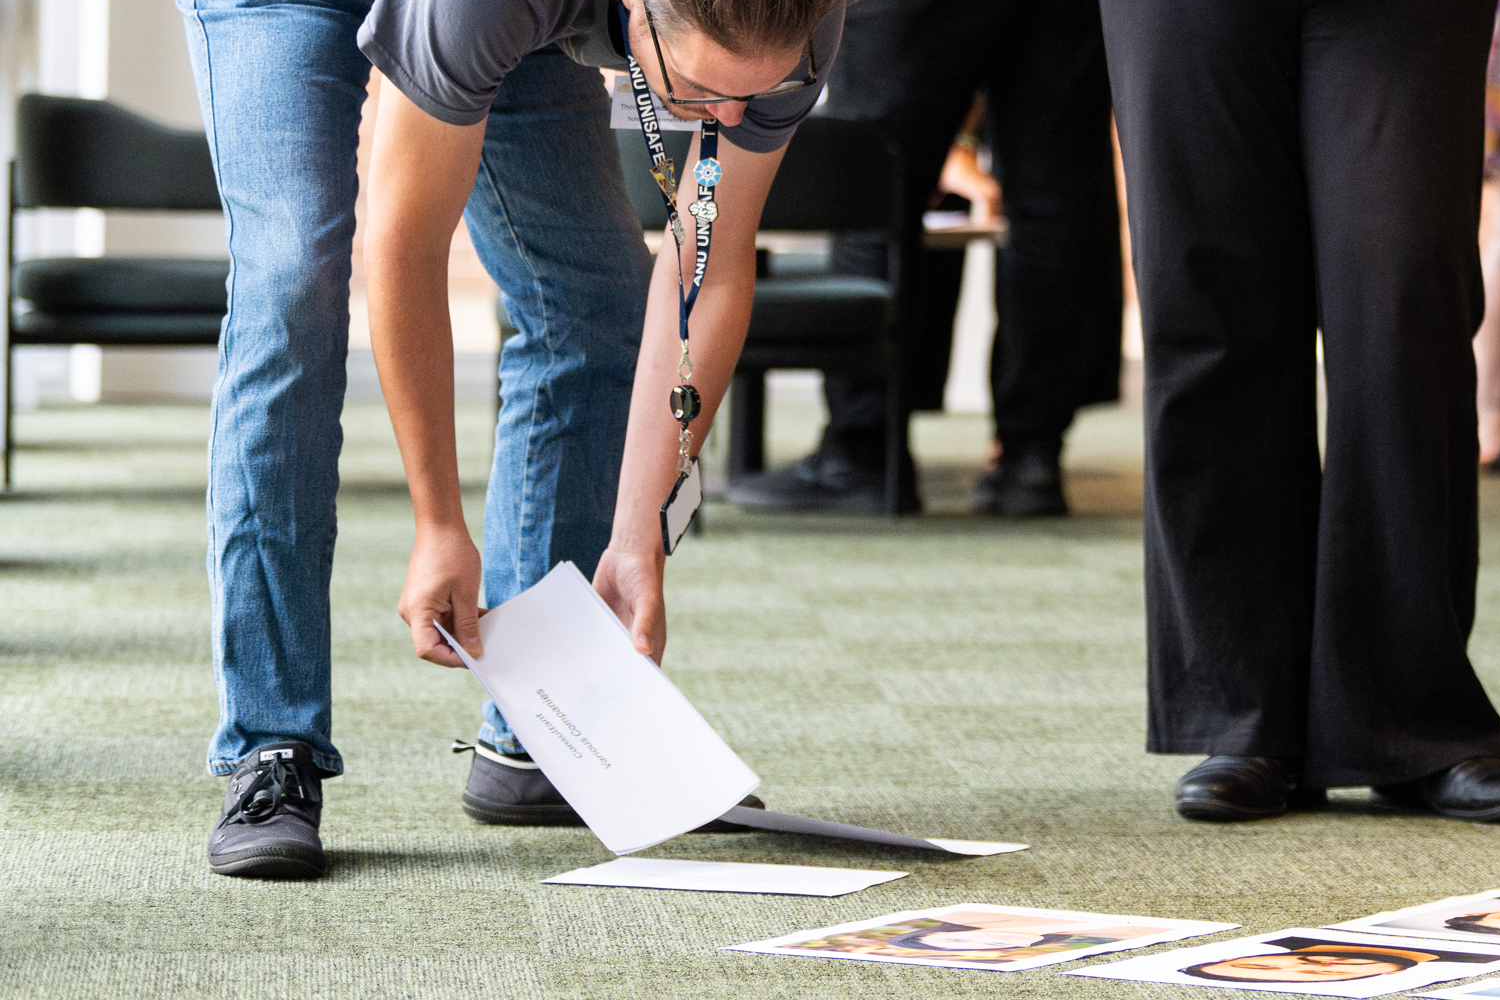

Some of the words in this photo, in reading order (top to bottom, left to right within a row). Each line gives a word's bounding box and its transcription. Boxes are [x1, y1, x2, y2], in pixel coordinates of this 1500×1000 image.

[628, 56, 647, 90] ANU
[637, 94, 666, 166] UNISAFE
[693, 251, 708, 287] ANU
[536, 688, 581, 737] Companies
[536, 712, 583, 759] Consultant
[580, 737, 612, 770] Various
